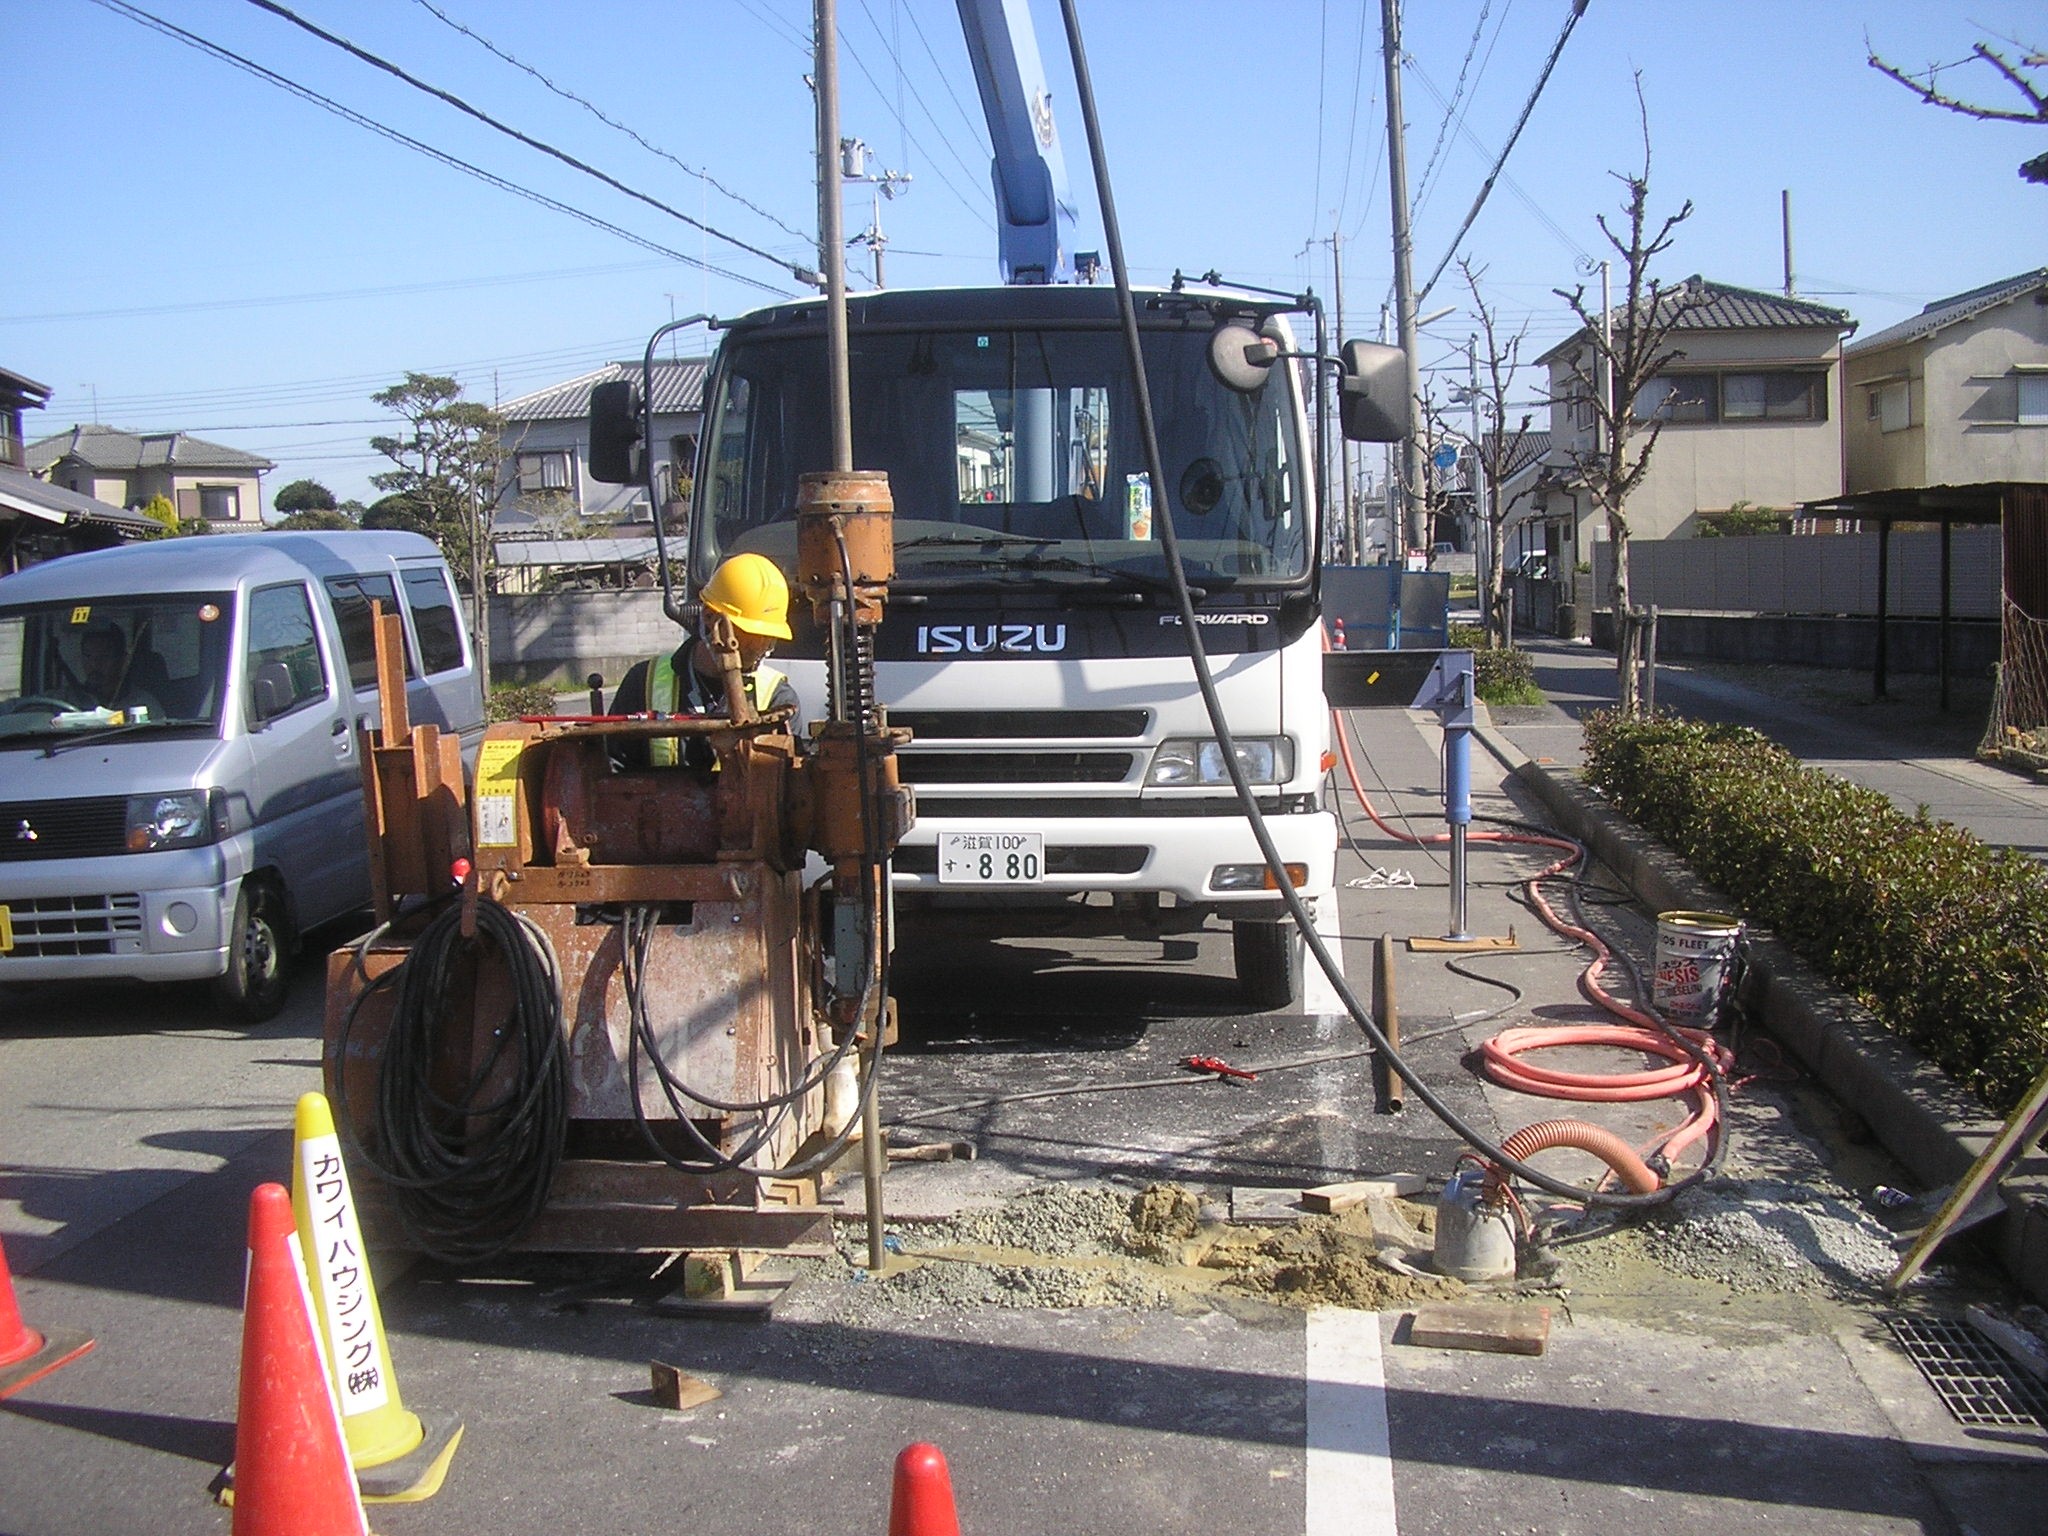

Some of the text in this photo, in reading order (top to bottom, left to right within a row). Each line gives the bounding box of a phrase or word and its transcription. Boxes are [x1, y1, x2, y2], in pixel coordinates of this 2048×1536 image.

[918, 624, 1066, 653] ISUZU
[945, 859, 957, 873] す
[1679, 938, 1709, 950] FLEET
